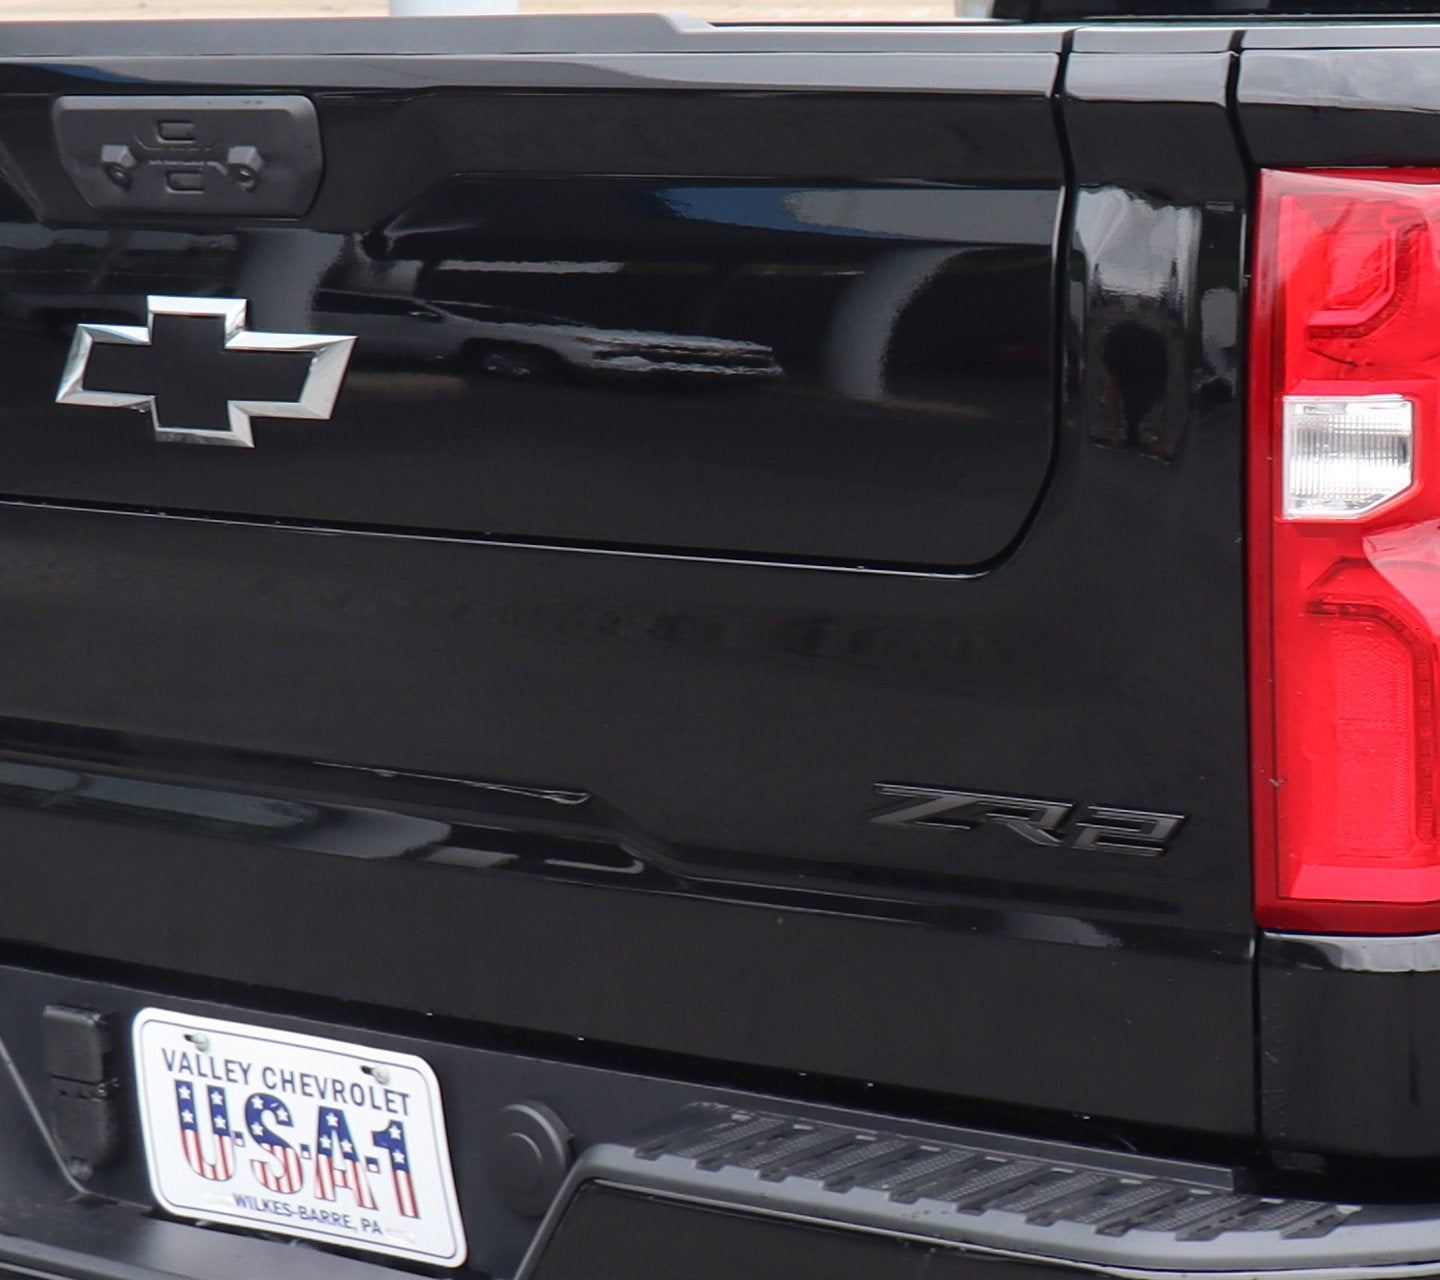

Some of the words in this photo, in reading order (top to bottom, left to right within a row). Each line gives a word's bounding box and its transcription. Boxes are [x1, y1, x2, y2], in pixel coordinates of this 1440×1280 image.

[868, 782, 1185, 857] ZR2
[161, 1047, 252, 1085] VALLEY
[262, 1066, 410, 1116] CHEVROLET
[232, 1193, 357, 1232] WILKES-BARRE,
[362, 1219, 383, 1236] PA
